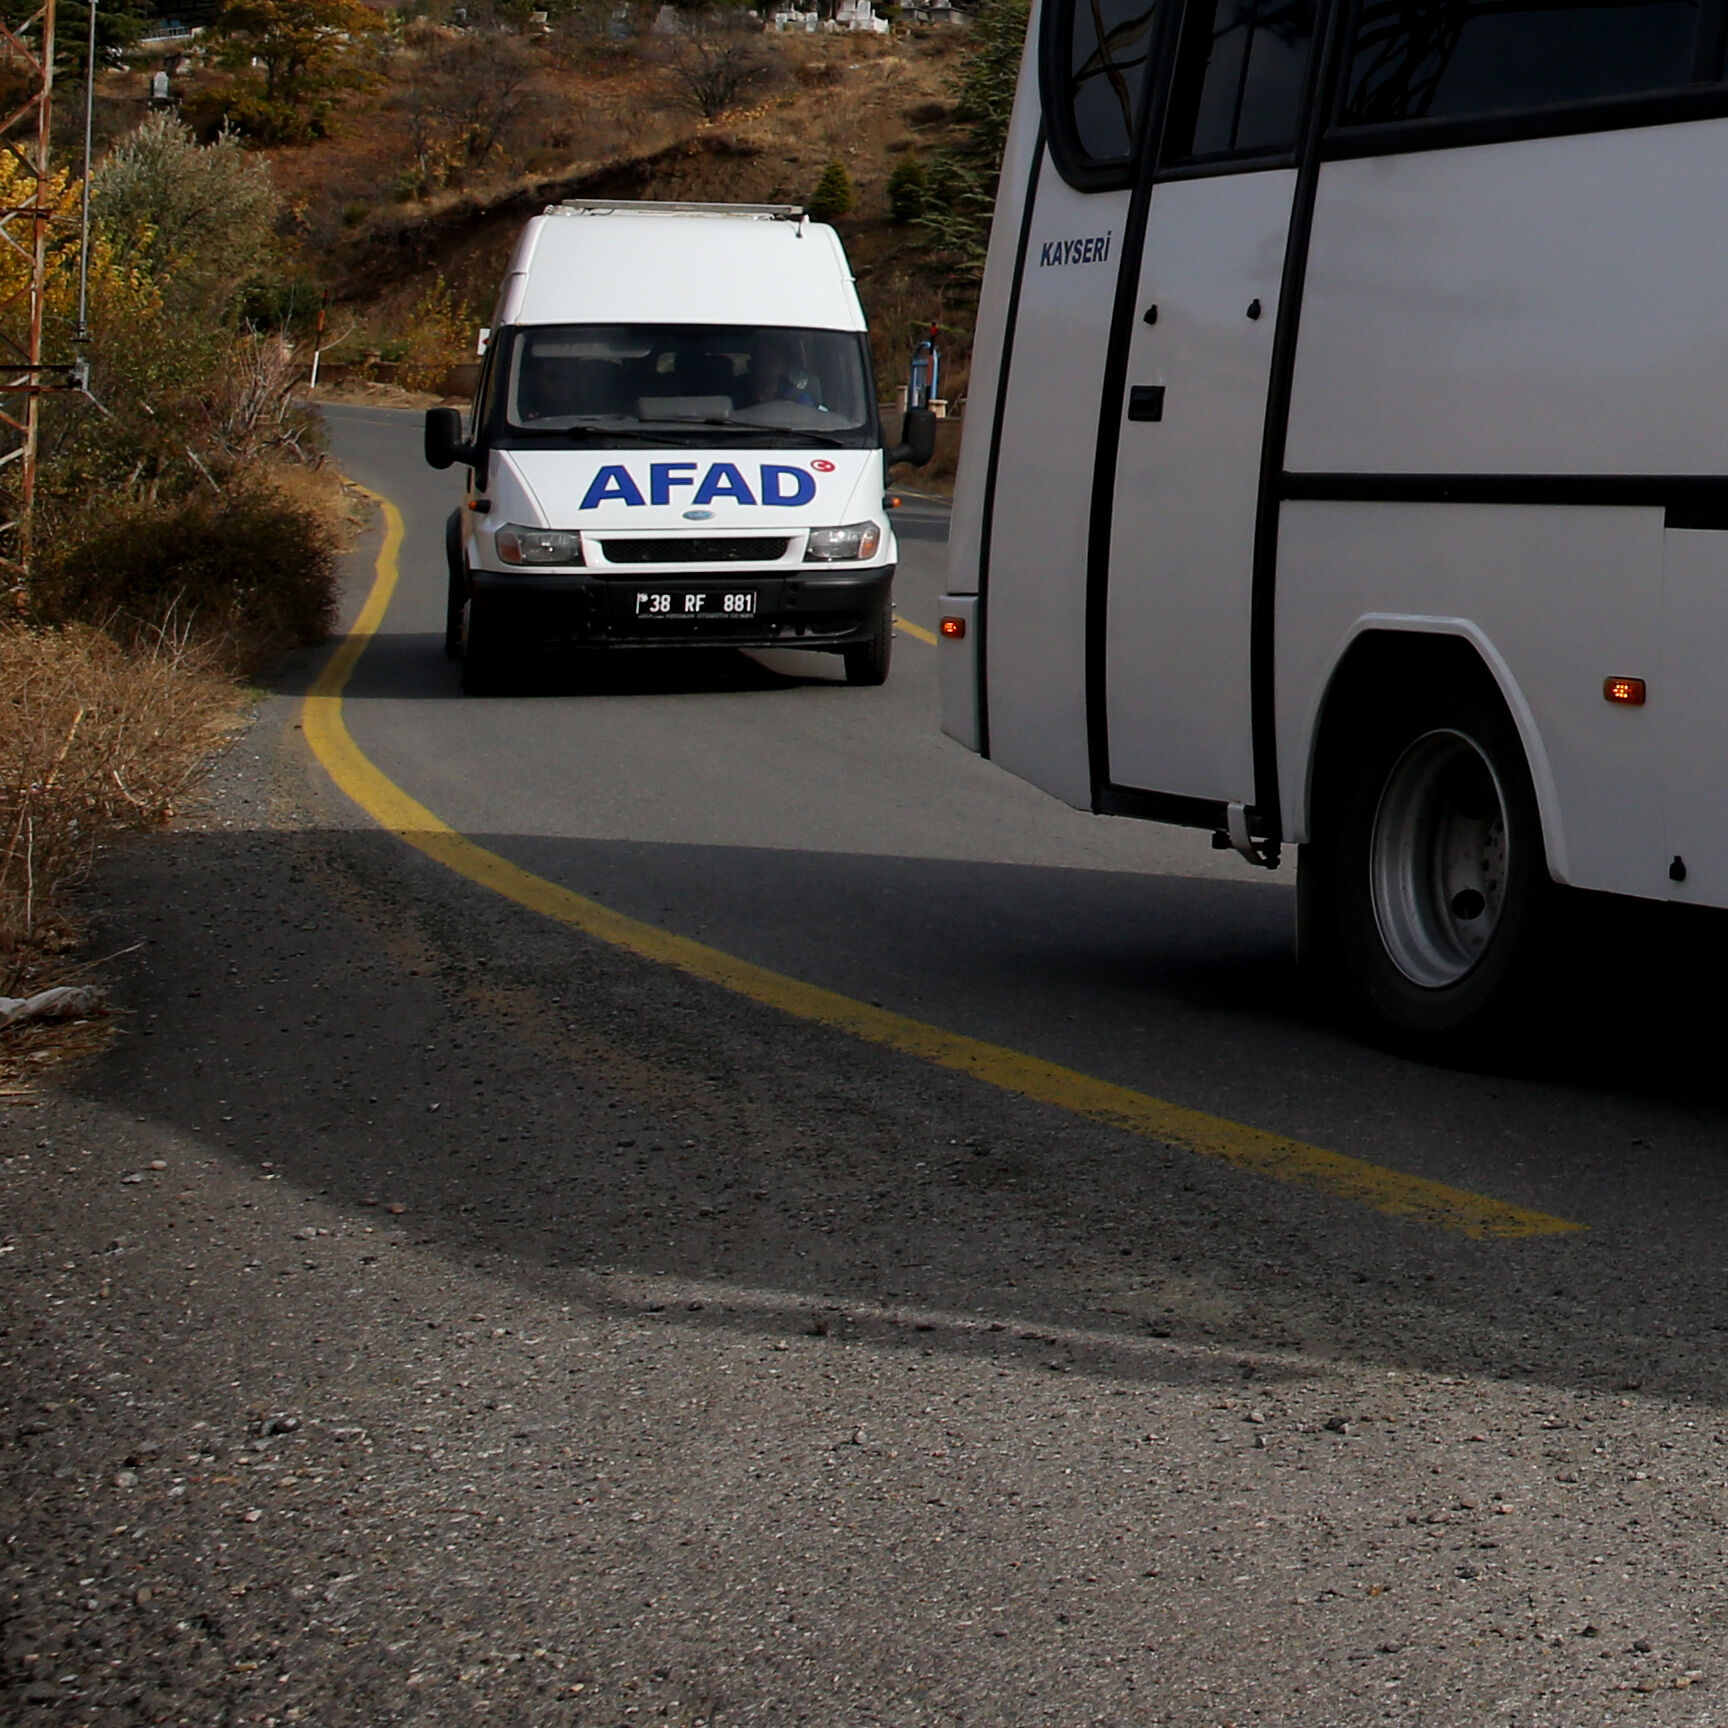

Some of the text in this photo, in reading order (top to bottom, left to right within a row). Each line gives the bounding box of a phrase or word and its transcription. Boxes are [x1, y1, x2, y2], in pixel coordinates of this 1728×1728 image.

[1040, 230, 1112, 267] KAYSERİ
[578, 462, 816, 510] AFAD
[649, 594, 752, 613] 38 RF 881
